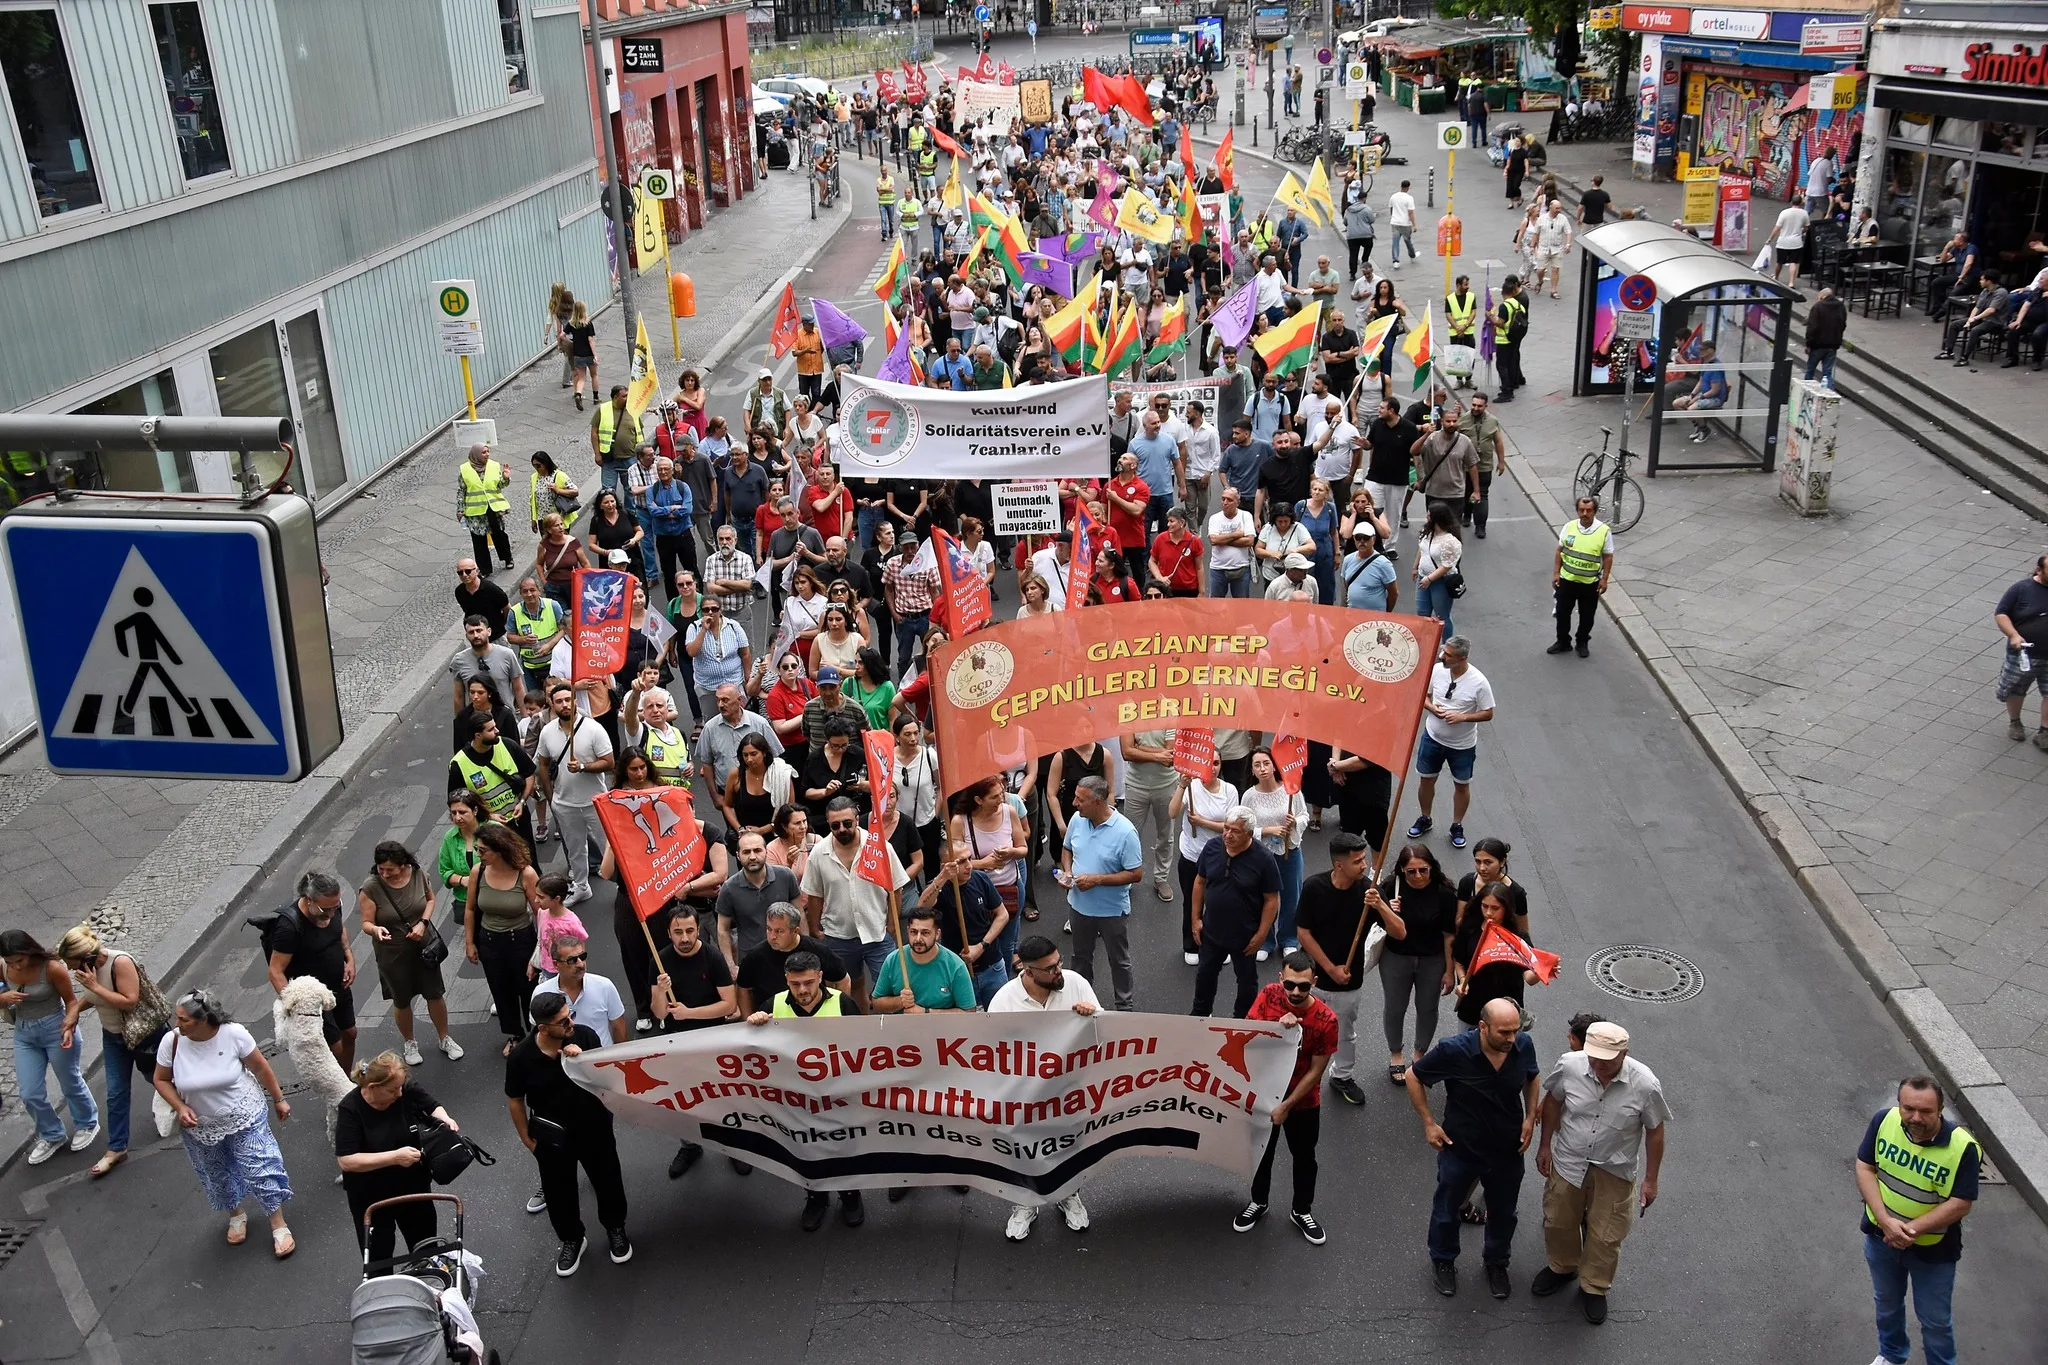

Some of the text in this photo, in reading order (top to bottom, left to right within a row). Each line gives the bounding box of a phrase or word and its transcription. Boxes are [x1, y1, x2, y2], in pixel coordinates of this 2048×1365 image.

[1703, 17, 1755, 32] ortel MOBILE
[1136, 34, 1142, 43] U
[1961, 43, 2048, 85] Simitd
[1834, 92, 1852, 105] BVG
[1696, 168, 1716, 176] LOTTO
[652, 179, 662, 191] H
[447, 293, 461, 310] H
[1620, 321, 1650, 330] fahrzeuge
[1622, 314, 1648, 322] Einsatz-
[925, 424, 1106, 437] Solidaritätsverein e.V.
[969, 443, 1061, 456] 7canlar.de
[1032, 484, 1048, 492] 1993
[998, 494, 1054, 507] Unutmadık,
[1006, 508, 1046, 519] unuttur-
[1354, 620, 1414, 643] GAZİANTEP
[1088, 632, 1268, 662] GAZİANTEP
[951, 642, 1006, 672] GAZİANTEP
[1368, 656, 1394, 668] GÇD
[969, 680, 992, 694] GÇD
[990, 664, 1366, 728] ÇEPNİLERİ DERNEĞİ e.V.
[1118, 692, 1236, 724] BERLİN
[1174, 738, 1210, 754] Berlin
[652, 841, 680, 868] Berlin
[638, 836, 699, 896] Alevi Toplumu
[654, 858, 692, 891] Cemevi
[796, 1044, 923, 1082] Sivas
[936, 1037, 1159, 1079] Katliamını
[652, 1061, 1258, 1126] nutmadık unutturmayacağız!
[722, 1095, 1228, 1160] gedenken an das Sivas-Massaker
[1878, 1138, 1950, 1185] ORDNER
